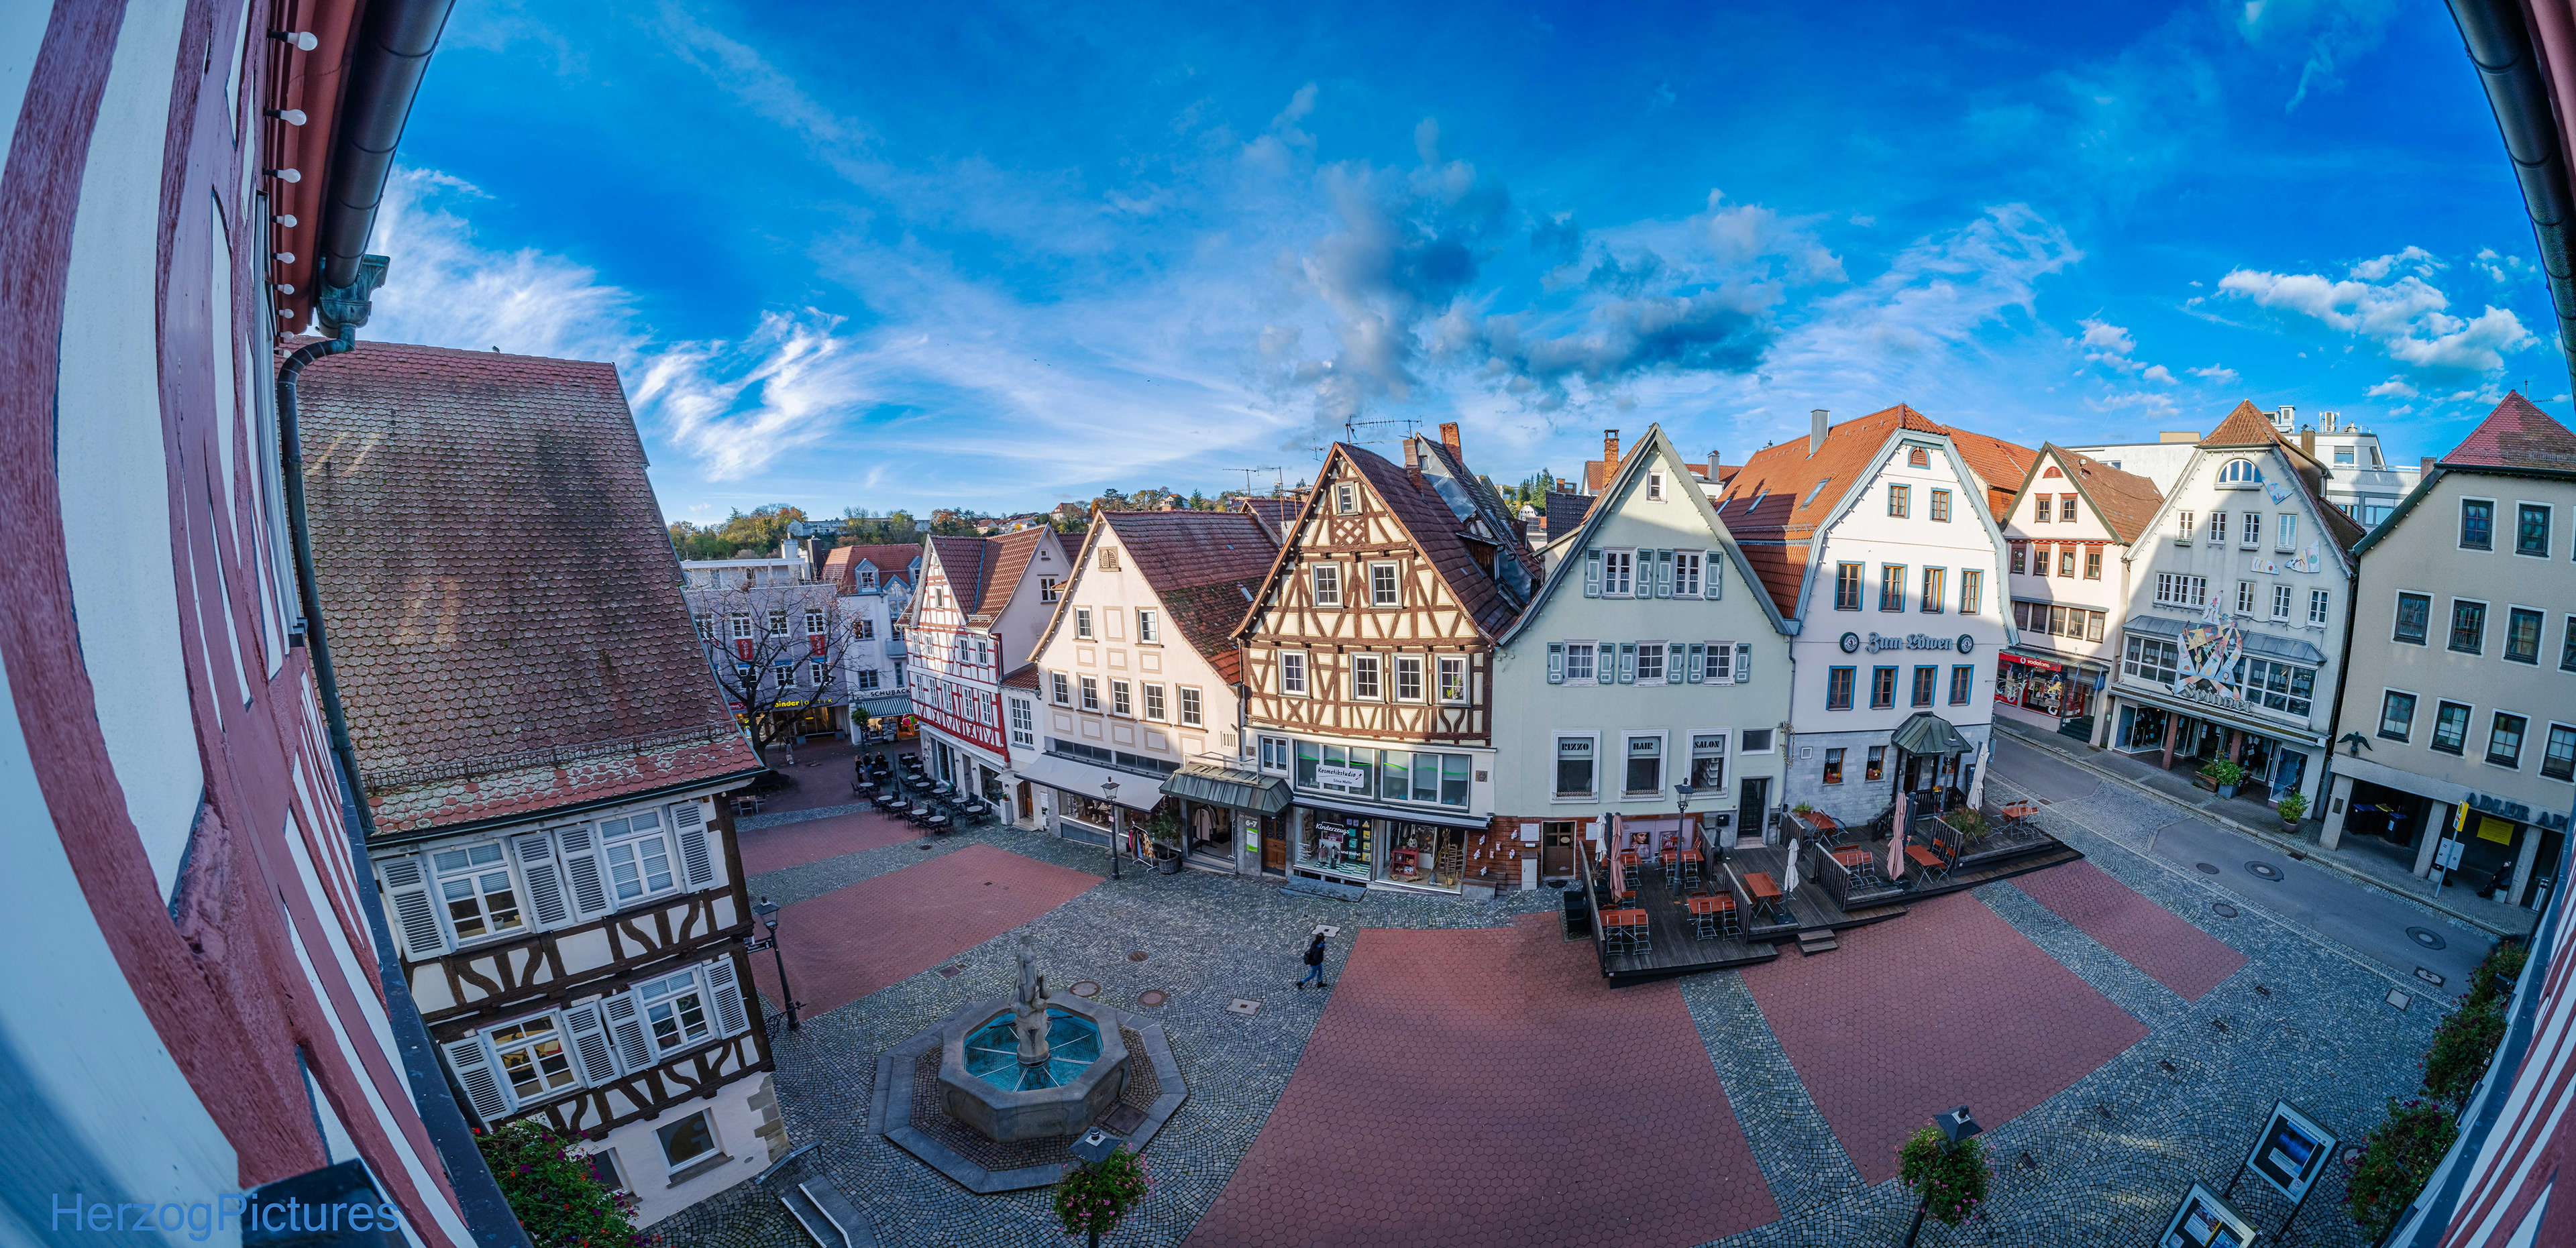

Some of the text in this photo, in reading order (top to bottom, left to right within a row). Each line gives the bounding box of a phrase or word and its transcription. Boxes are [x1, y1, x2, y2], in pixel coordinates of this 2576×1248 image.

[1865, 632, 1902, 654] Zum
[1906, 633, 1953, 650] Löwen
[2027, 660, 2050, 668] vodafone
[871, 688, 911, 697] SCHUBACK
[1561, 743, 1589, 751] RIZZO
[1633, 742, 1654, 750] HAIR
[1695, 740, 1720, 748] SALON
[1318, 767, 1356, 777] Kosmetikstudio
[2466, 793, 2529, 821] ADLER
[1245, 819, 1258, 828] 6-7
[1316, 823, 1350, 835] Kinderzeugs
[2306, 1128, 2321, 1141] Backnang
[2214, 1208, 2245, 1237] Bekanntmachungen
